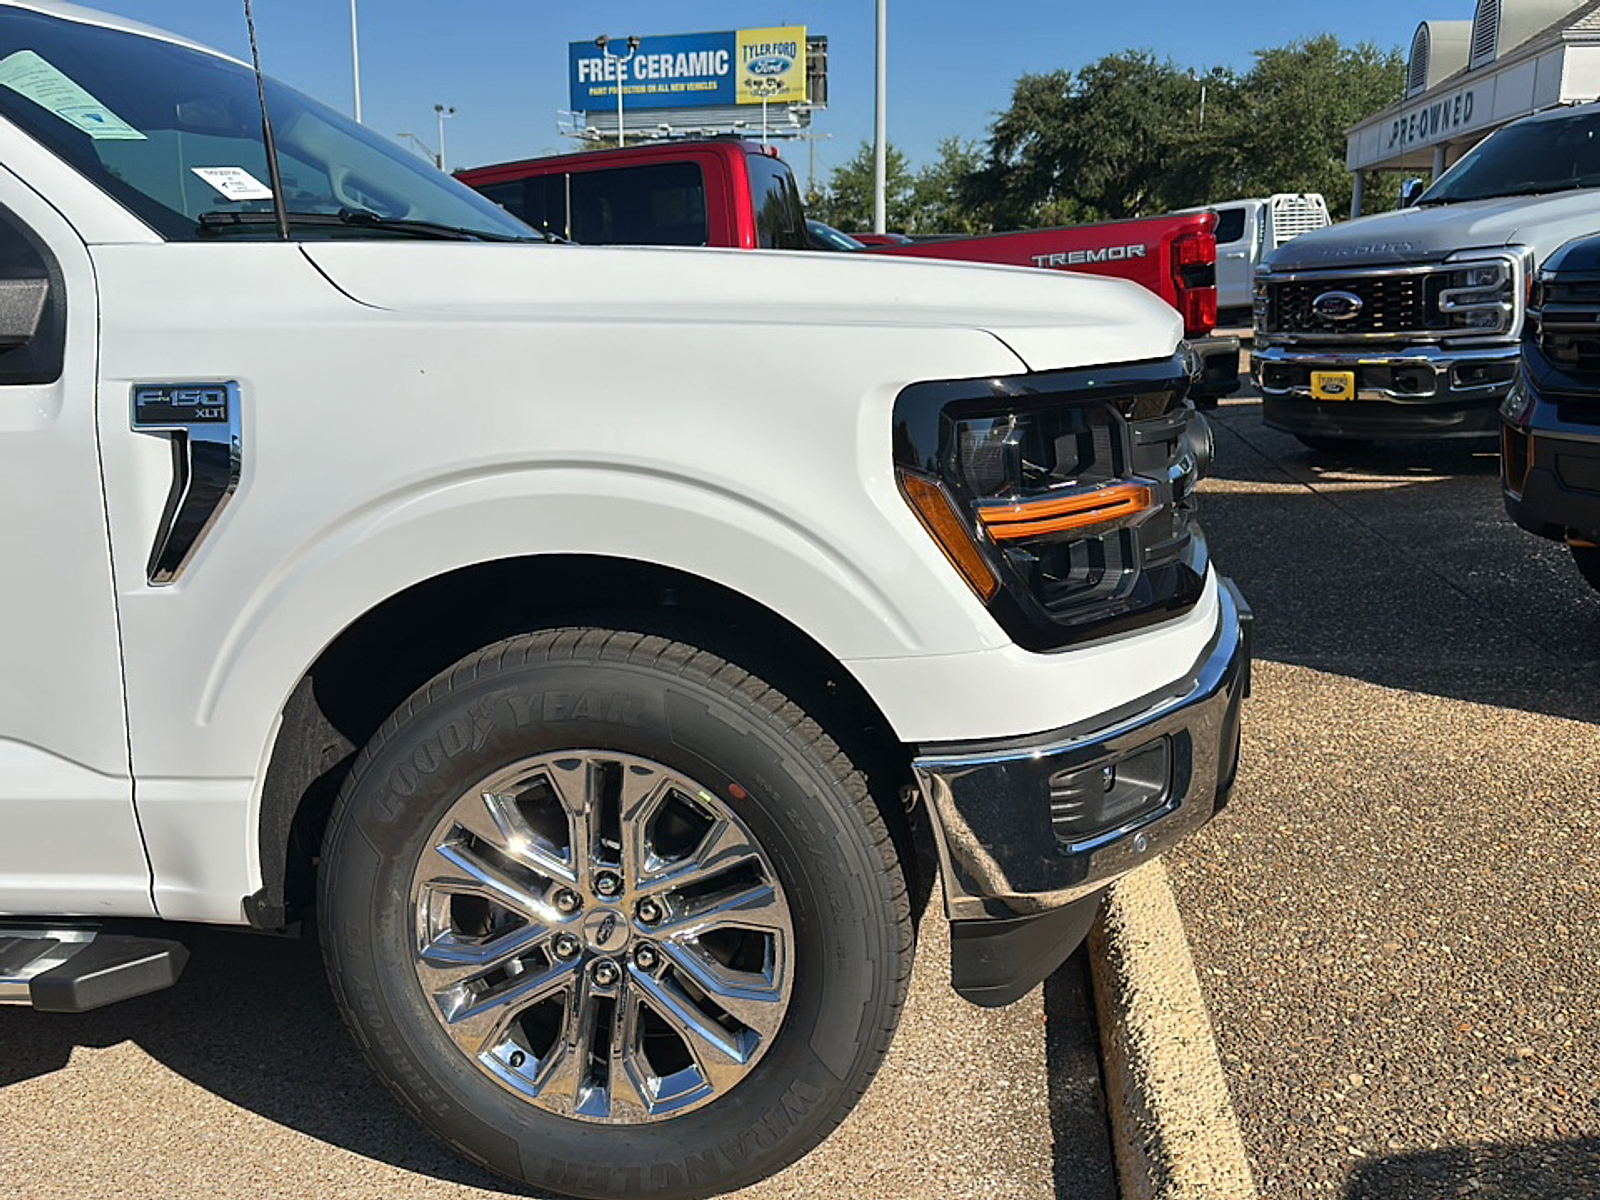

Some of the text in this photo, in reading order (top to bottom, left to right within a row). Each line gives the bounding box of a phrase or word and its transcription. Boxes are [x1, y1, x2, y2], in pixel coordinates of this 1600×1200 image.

[743, 42, 796, 63] TYLER FORD
[578, 50, 729, 83] FREE CERAMIC
[755, 59, 783, 73] Ford
[1390, 91, 1474, 147] PRE-OWNED
[1032, 244, 1146, 268] TREMOR
[137, 390, 225, 407] F-150
[195, 407, 223, 418] XLT
[544, 1079, 823, 1192] WRANGLER
